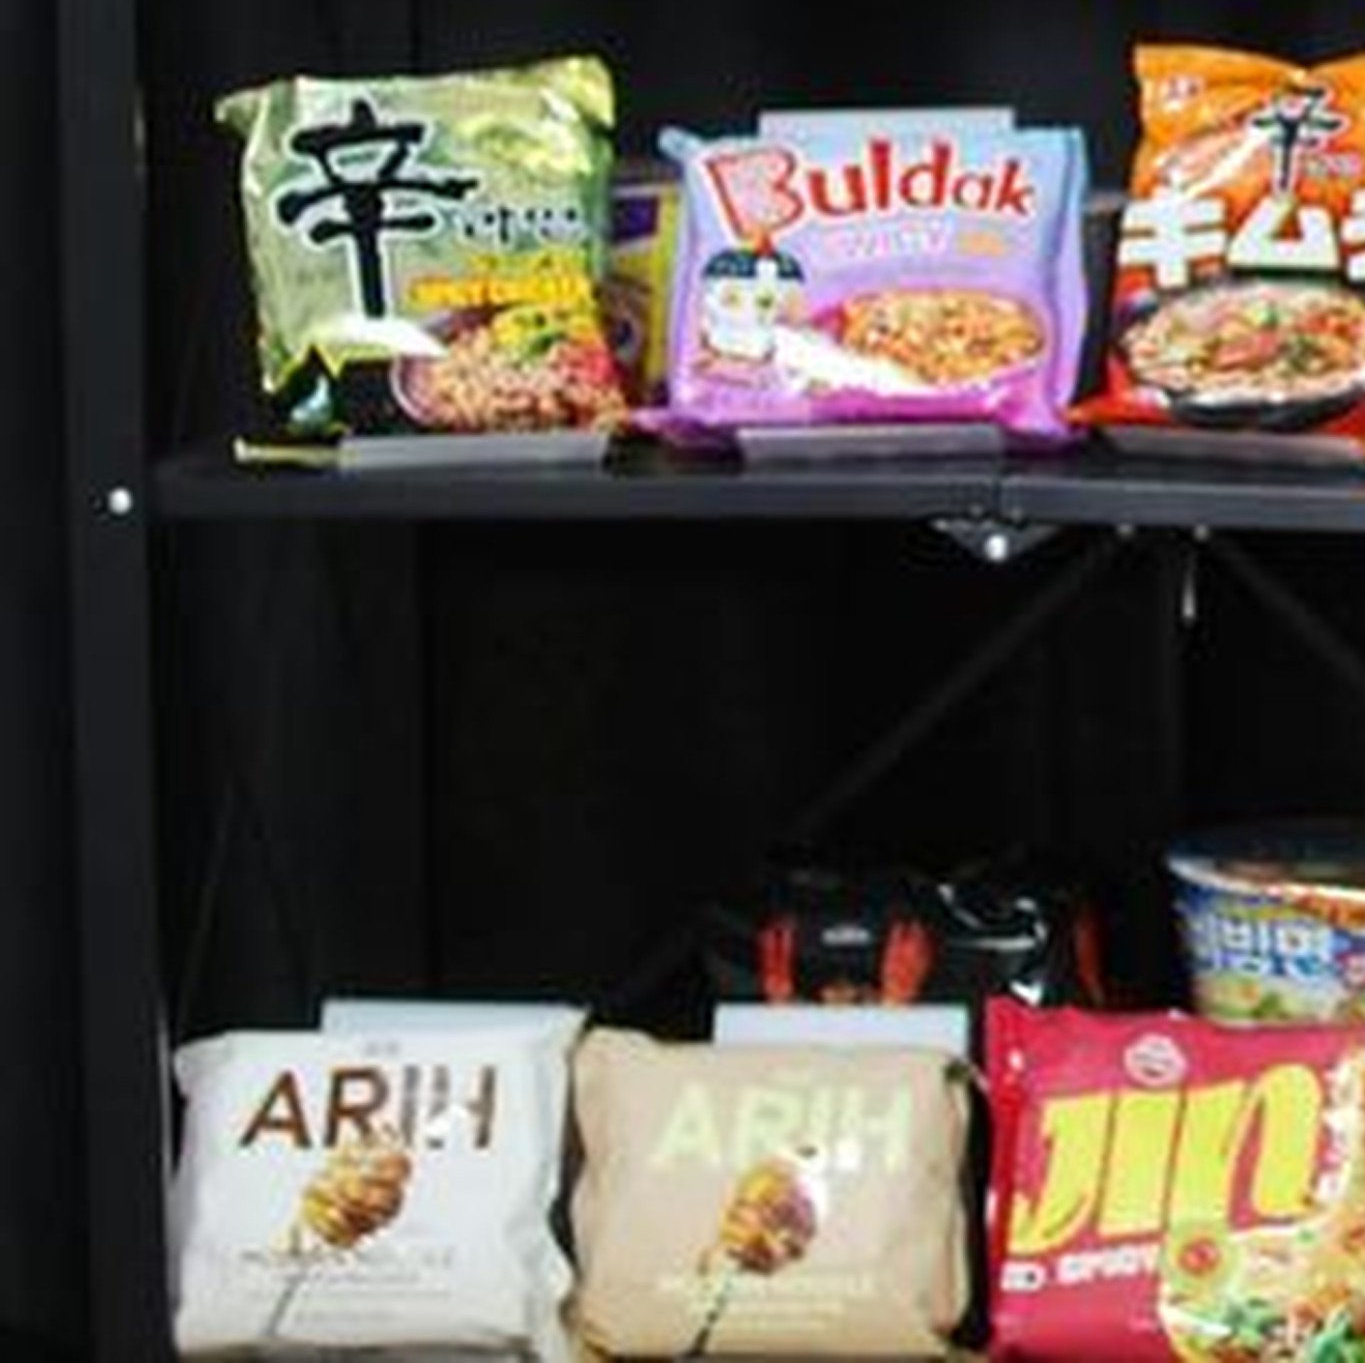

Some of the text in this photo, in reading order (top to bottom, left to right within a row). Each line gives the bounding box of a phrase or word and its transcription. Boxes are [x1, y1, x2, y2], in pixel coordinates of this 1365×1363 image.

[276, 98, 480, 320] 辛
[705, 138, 1038, 244] Buldak
[237, 1064, 498, 1151] ARIH
[648, 1082, 914, 1172] ARIH
